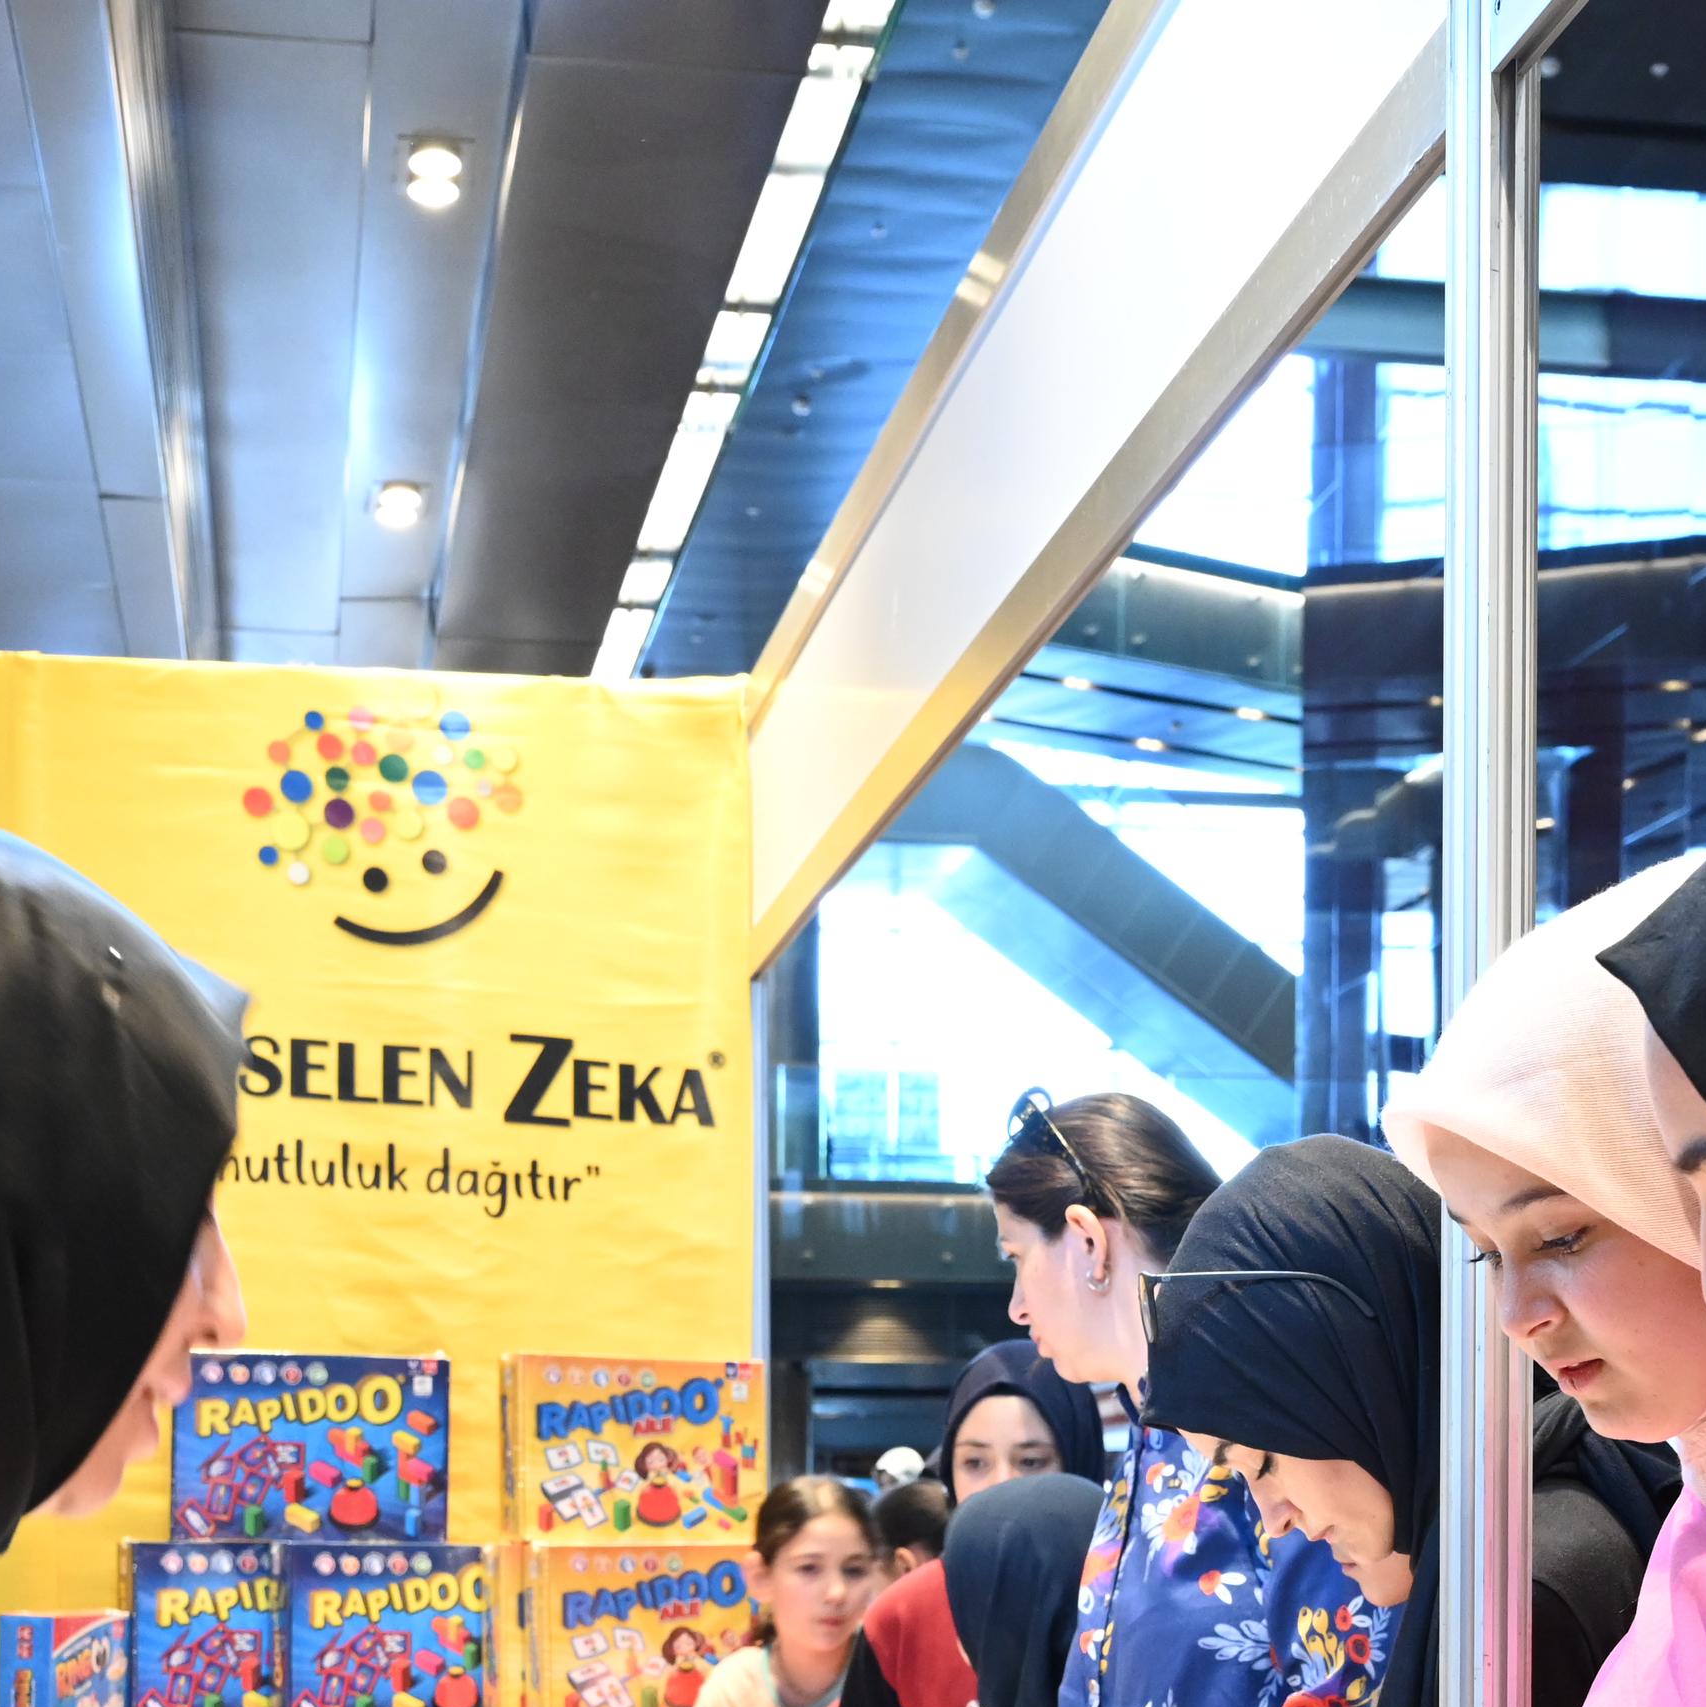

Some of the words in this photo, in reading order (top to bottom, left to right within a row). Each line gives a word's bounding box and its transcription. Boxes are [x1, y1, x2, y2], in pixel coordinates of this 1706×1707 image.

[503, 1032, 717, 1128] ZEKA
[196, 1373, 403, 1437] RAPIDOO
[536, 1377, 720, 1441] RAPIDOO
